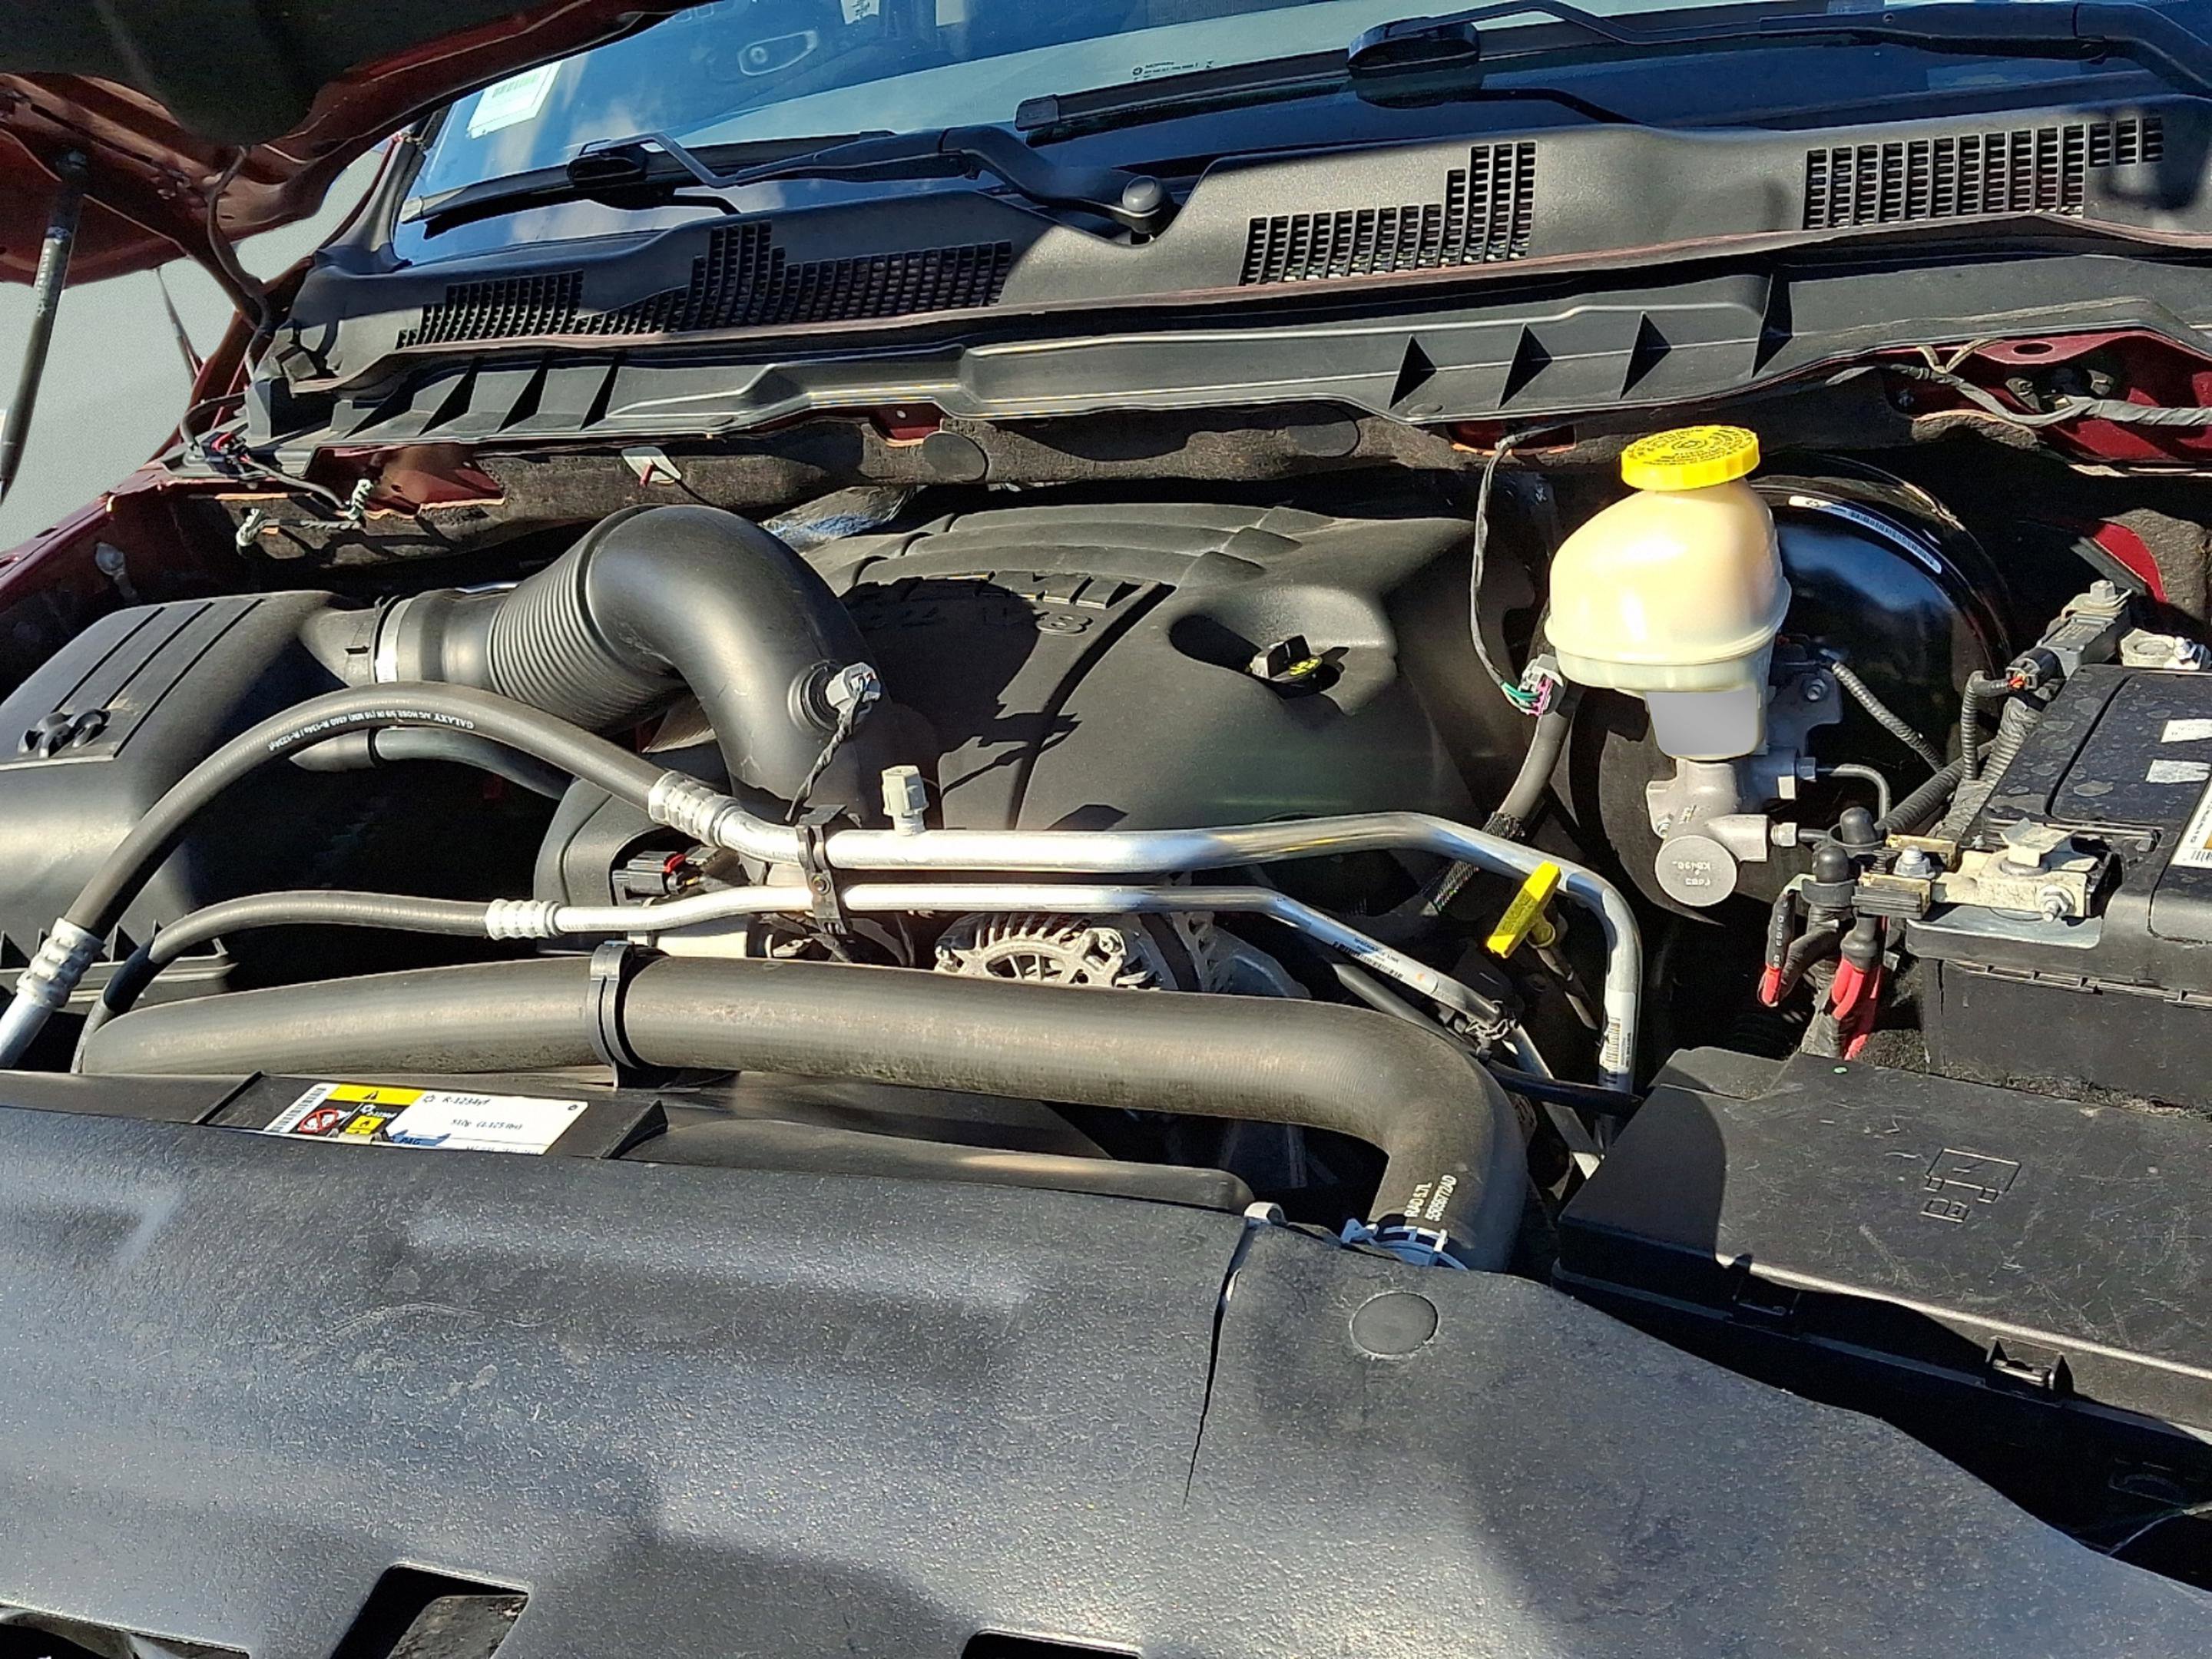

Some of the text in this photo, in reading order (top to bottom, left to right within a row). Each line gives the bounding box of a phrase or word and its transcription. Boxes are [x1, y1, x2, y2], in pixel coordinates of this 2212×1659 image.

[397, 710, 418, 719] HOSE
[433, 713, 475, 730] GALAXY
[1403, 1182, 1432, 1217] RAD 5.7L
